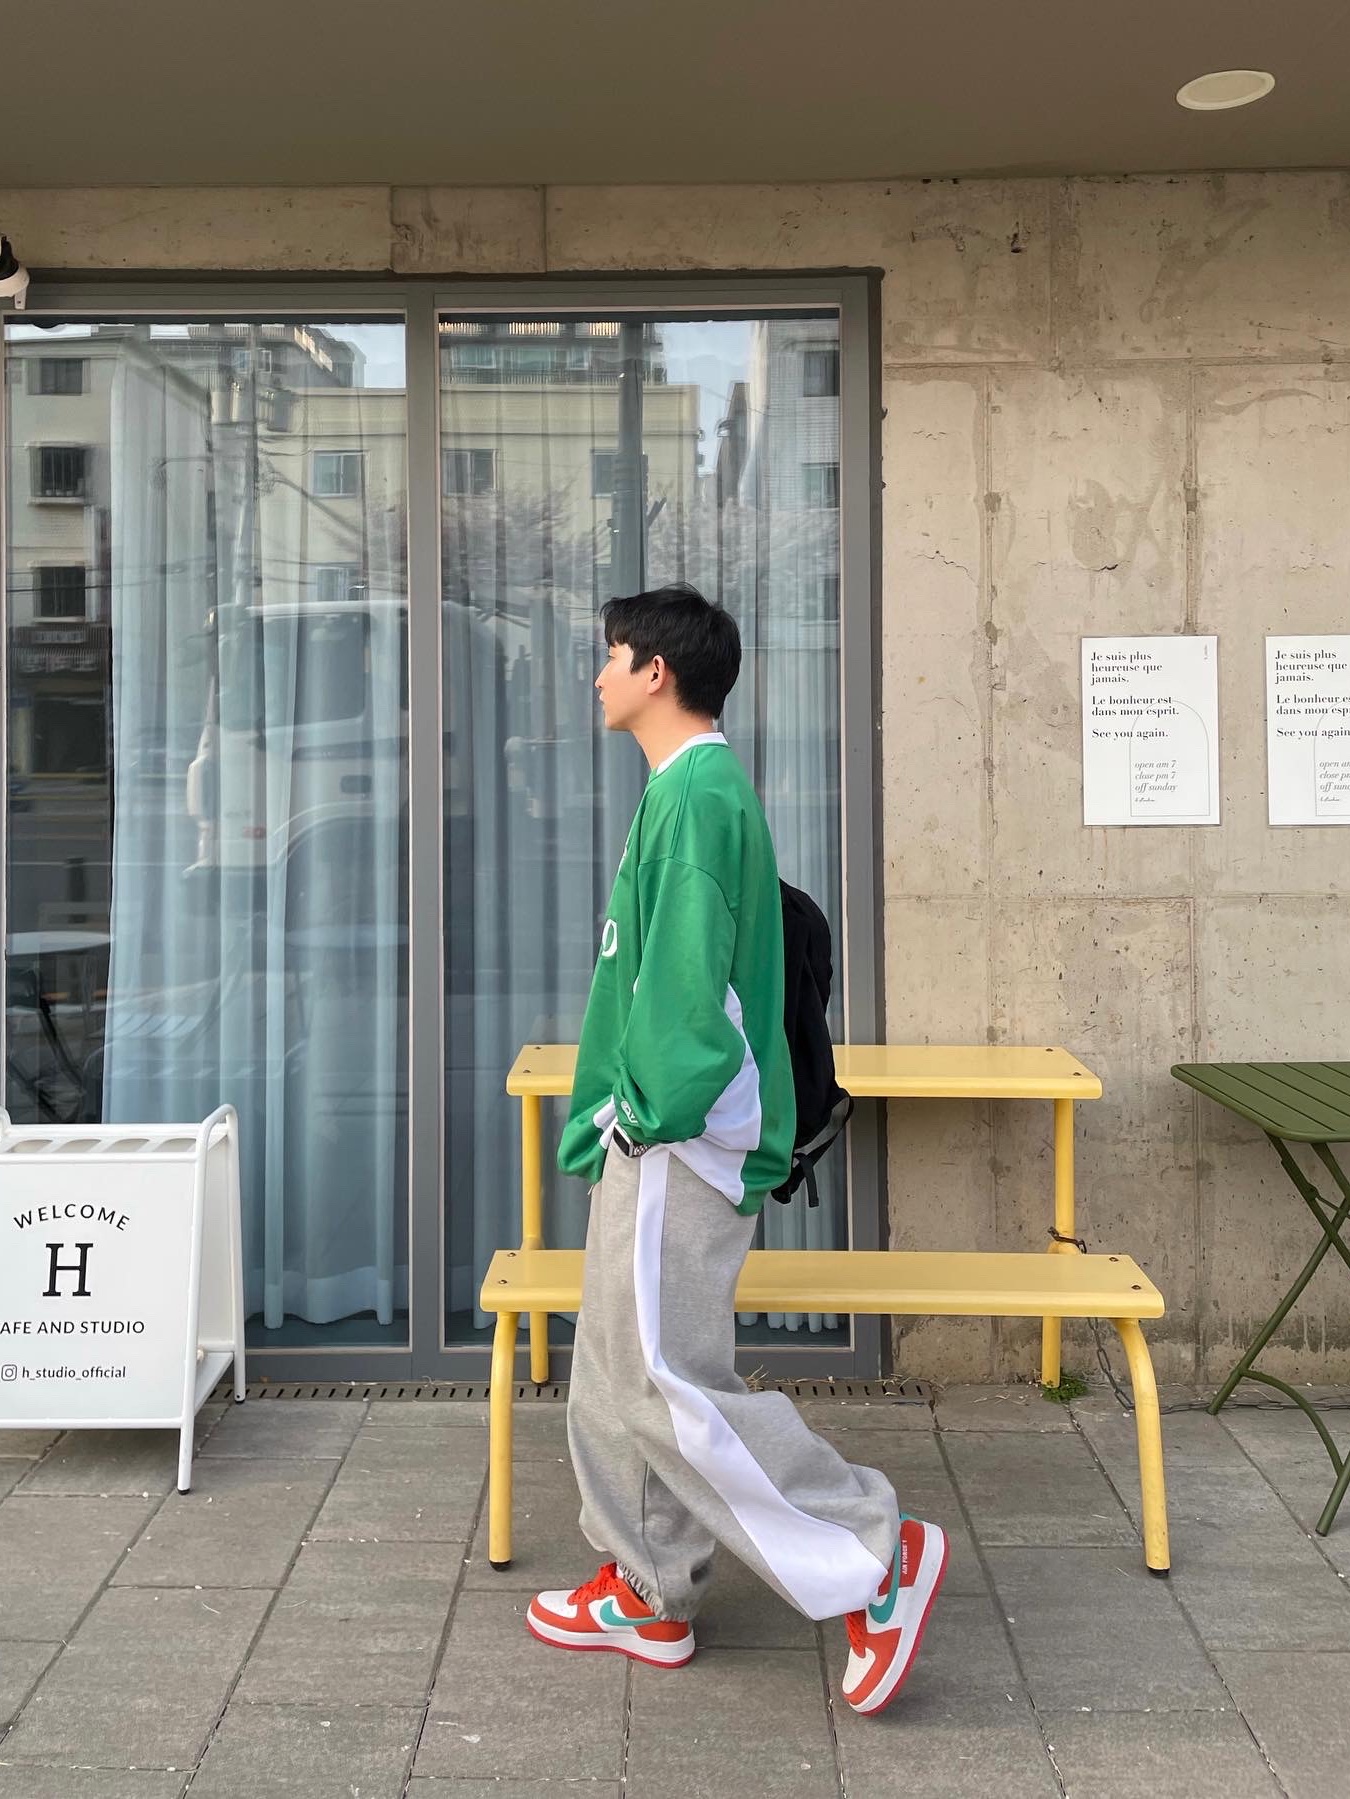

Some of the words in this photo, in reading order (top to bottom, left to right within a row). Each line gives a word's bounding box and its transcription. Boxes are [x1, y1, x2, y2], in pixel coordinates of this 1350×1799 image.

[1091, 652, 1102, 661] Je
[1106, 652, 1126, 660] suis
[1130, 651, 1151, 663] plus
[1275, 650, 1287, 659] Je
[1290, 650, 1311, 659] suis
[1315, 650, 1336, 662] plus
[1092, 662, 1139, 672] heureuse
[1143, 665, 1162, 674] que
[1276, 661, 1324, 670] heureuse
[1328, 664, 1347, 672] que
[1091, 674, 1129, 686] jamais.
[1275, 672, 1313, 684] jamais.
[1093, 696, 1105, 704] Le
[1110, 696, 1155, 706] bonheur
[1157, 696, 1172, 704] est
[1277, 695, 1290, 703] Le
[1294, 694, 1339, 703] bonheur
[1092, 707, 1116, 716] dans
[1147, 705, 1179, 718] esprit.
[1276, 706, 1301, 714] dans
[1092, 729, 1111, 737] See
[1114, 732, 1132, 740] you
[1137, 728, 1168, 740] again.
[1276, 728, 1296, 737] See
[1299, 730, 1317, 739] you
[1135, 763, 1154, 772] open
[1172, 760, 1176, 768] 7
[1319, 762, 1339, 772] open
[1135, 770, 1154, 780] close
[1155, 774, 1168, 783] pm
[1171, 771, 1176, 779] 7
[1320, 770, 1339, 779] close
[1135, 783, 1149, 793] off
[1149, 782, 1178, 792] sunday
[1320, 782, 1334, 792] off
[13, 1204, 130, 1231] WELCOME
[43, 1243, 93, 1297] H
[37, 1321, 74, 1334] AND
[80, 1321, 144, 1334] STUDIO
[22, 1366, 126, 1380] h_studio_official
